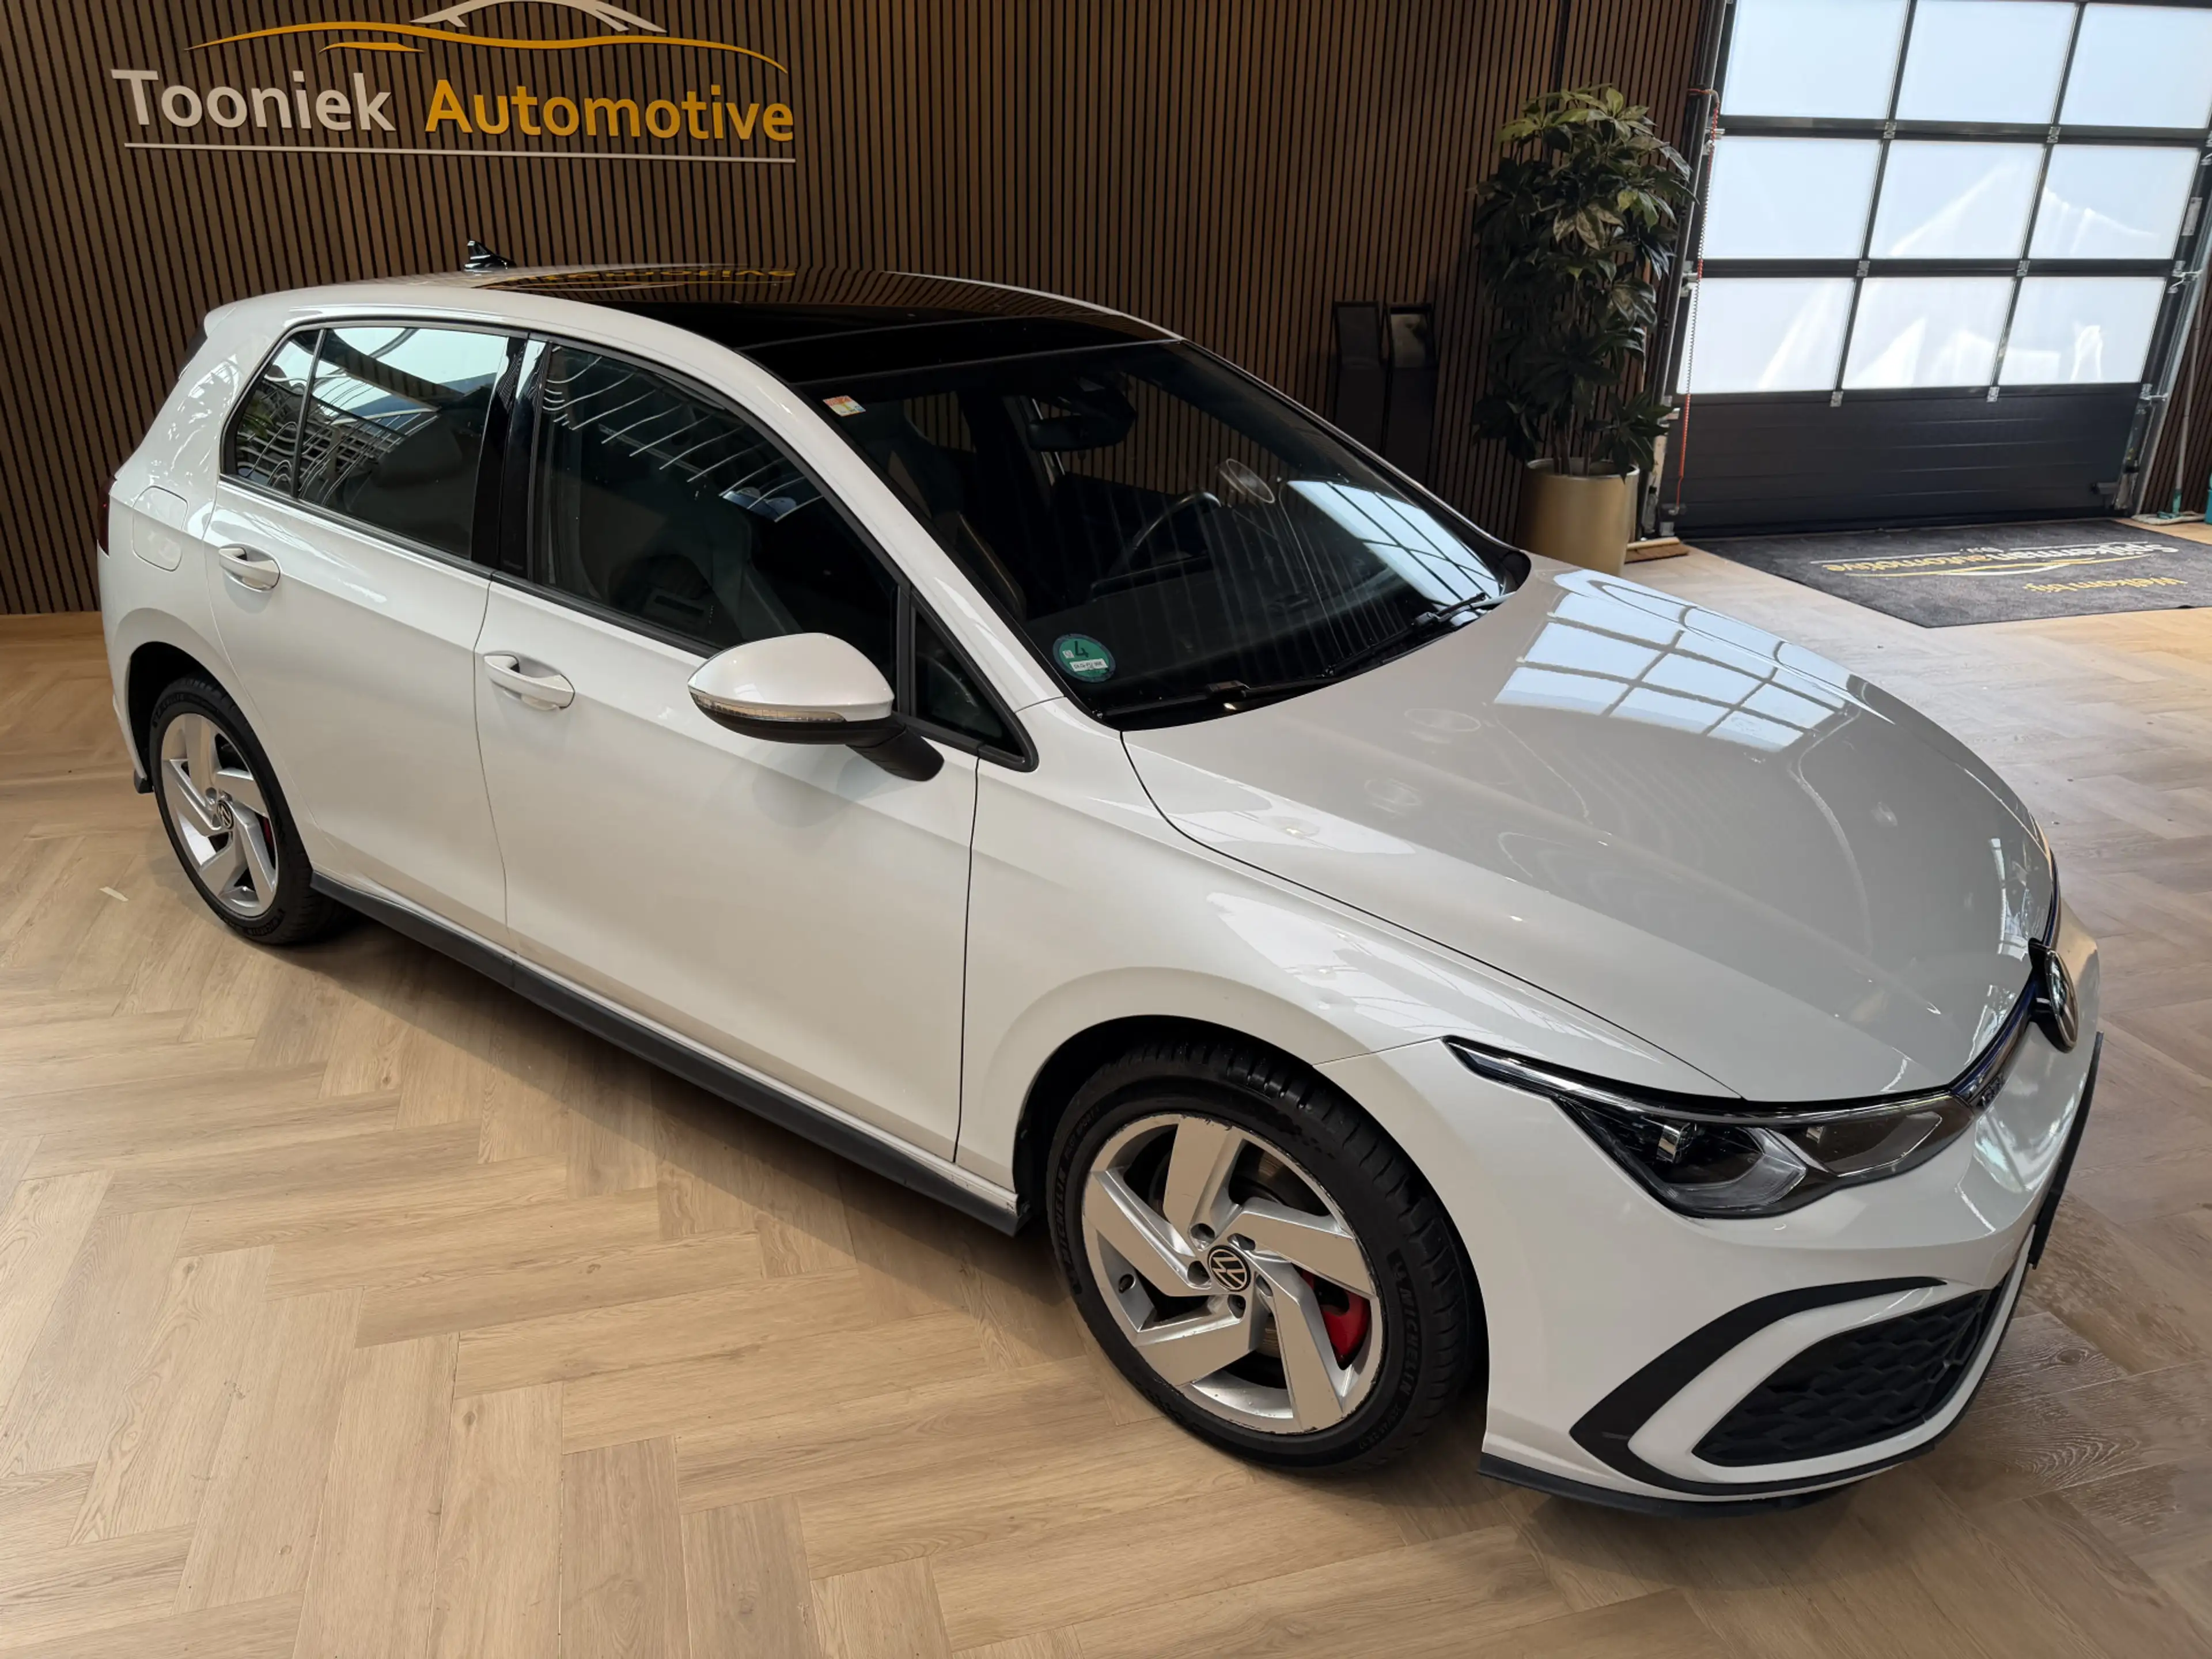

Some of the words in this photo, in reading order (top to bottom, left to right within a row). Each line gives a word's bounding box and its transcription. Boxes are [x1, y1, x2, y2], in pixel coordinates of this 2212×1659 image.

[111, 69, 395, 131] Tooniek
[425, 79, 795, 142] Automotive
[2067, 577, 2188, 589] Welkom
[1074, 641, 1089, 658] 4
[1399, 1287, 1419, 1396] MICHELIN
